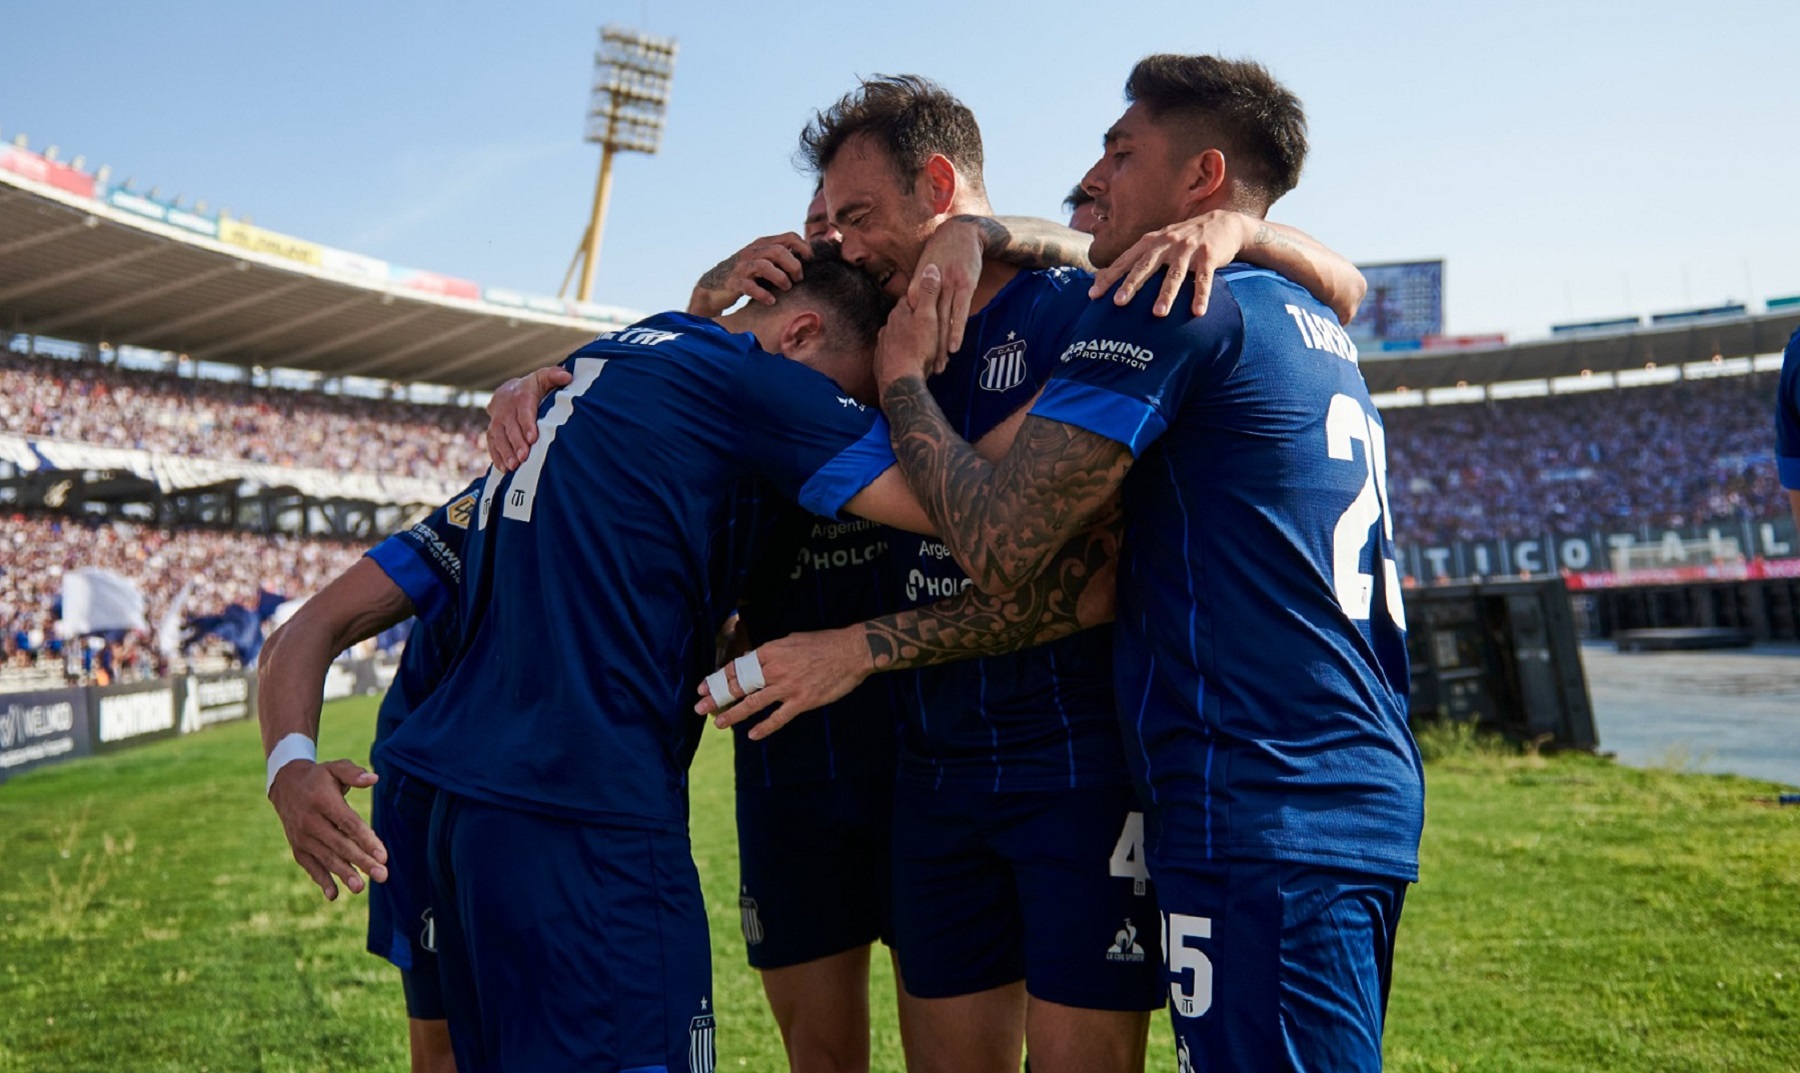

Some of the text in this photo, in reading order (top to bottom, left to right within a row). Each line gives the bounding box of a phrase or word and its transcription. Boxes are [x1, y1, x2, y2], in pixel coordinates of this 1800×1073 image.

[811, 518, 881, 539] Argentin
[1397, 536, 1591, 577] TICO
[1160, 909, 1213, 1018] 5
